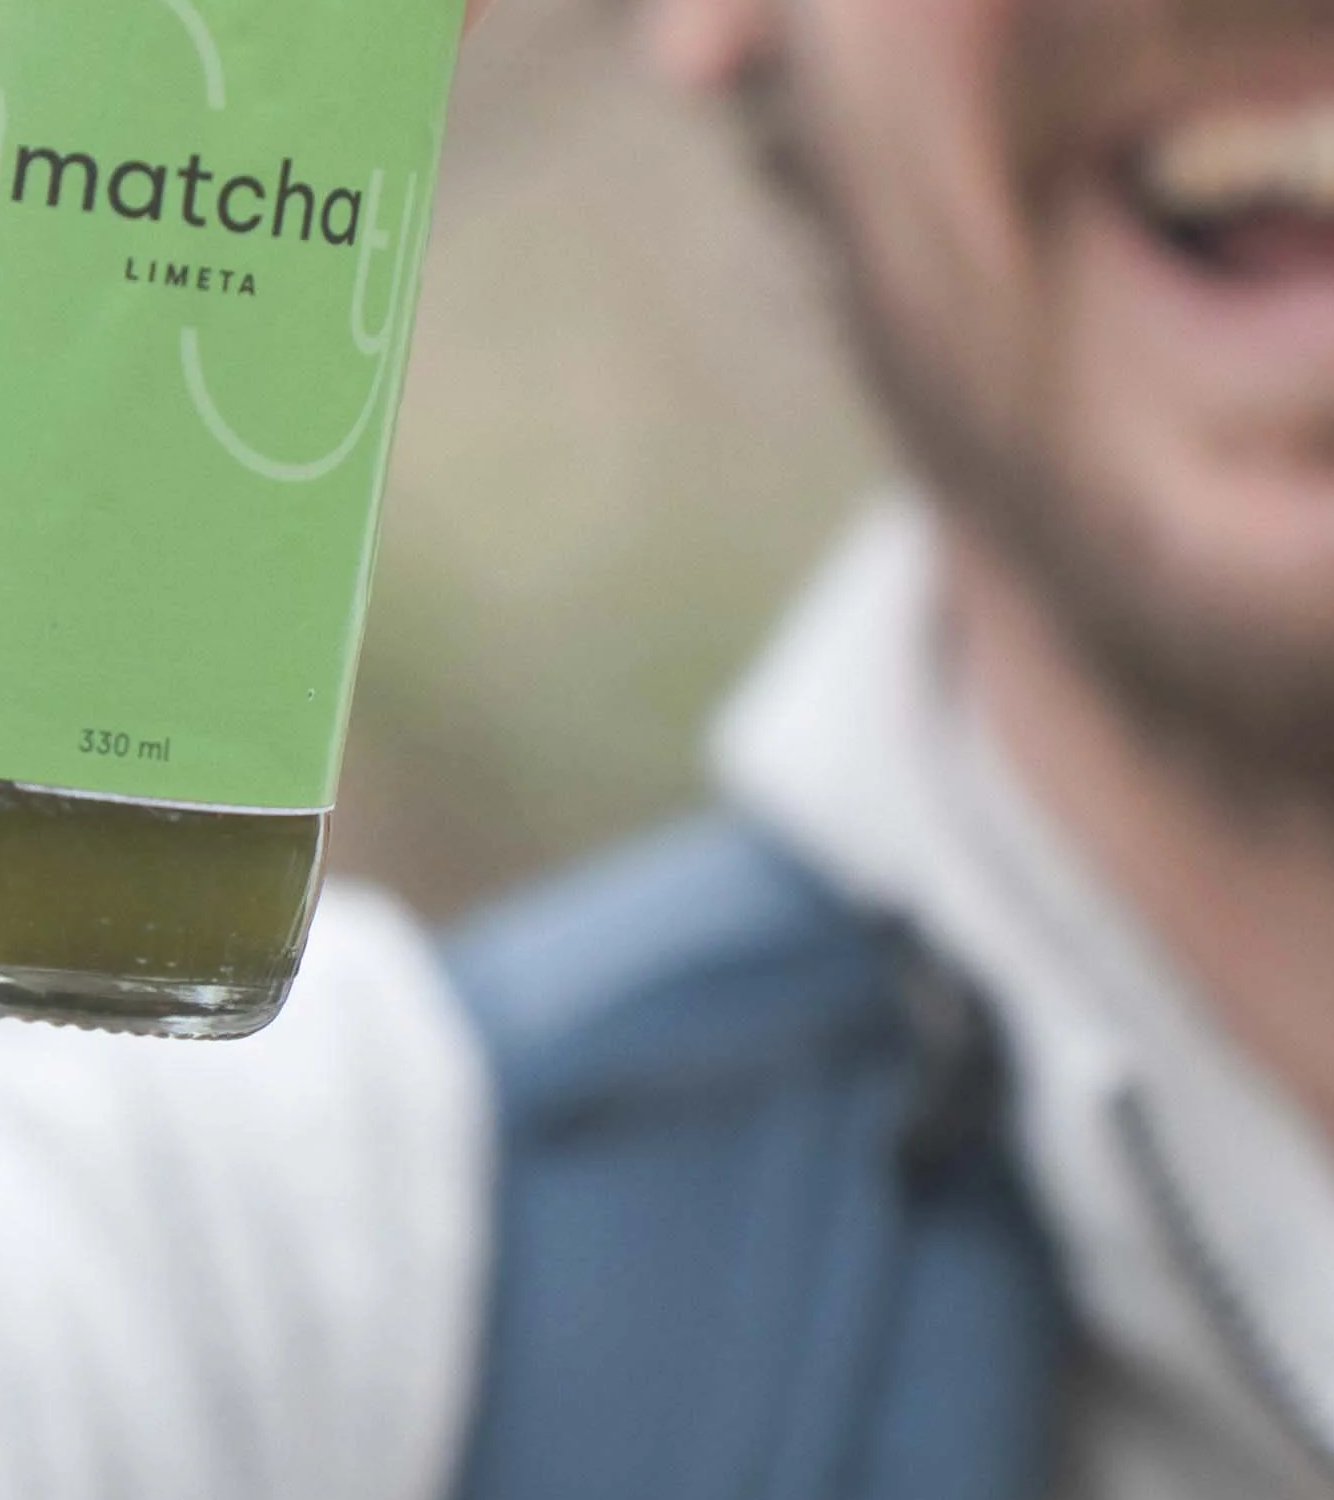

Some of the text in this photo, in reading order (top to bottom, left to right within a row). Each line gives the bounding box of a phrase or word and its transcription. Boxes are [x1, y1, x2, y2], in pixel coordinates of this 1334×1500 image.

[11, 146, 362, 246] matcha
[125, 258, 255, 296] LIMETA
[79, 729, 169, 761] 330 ml
